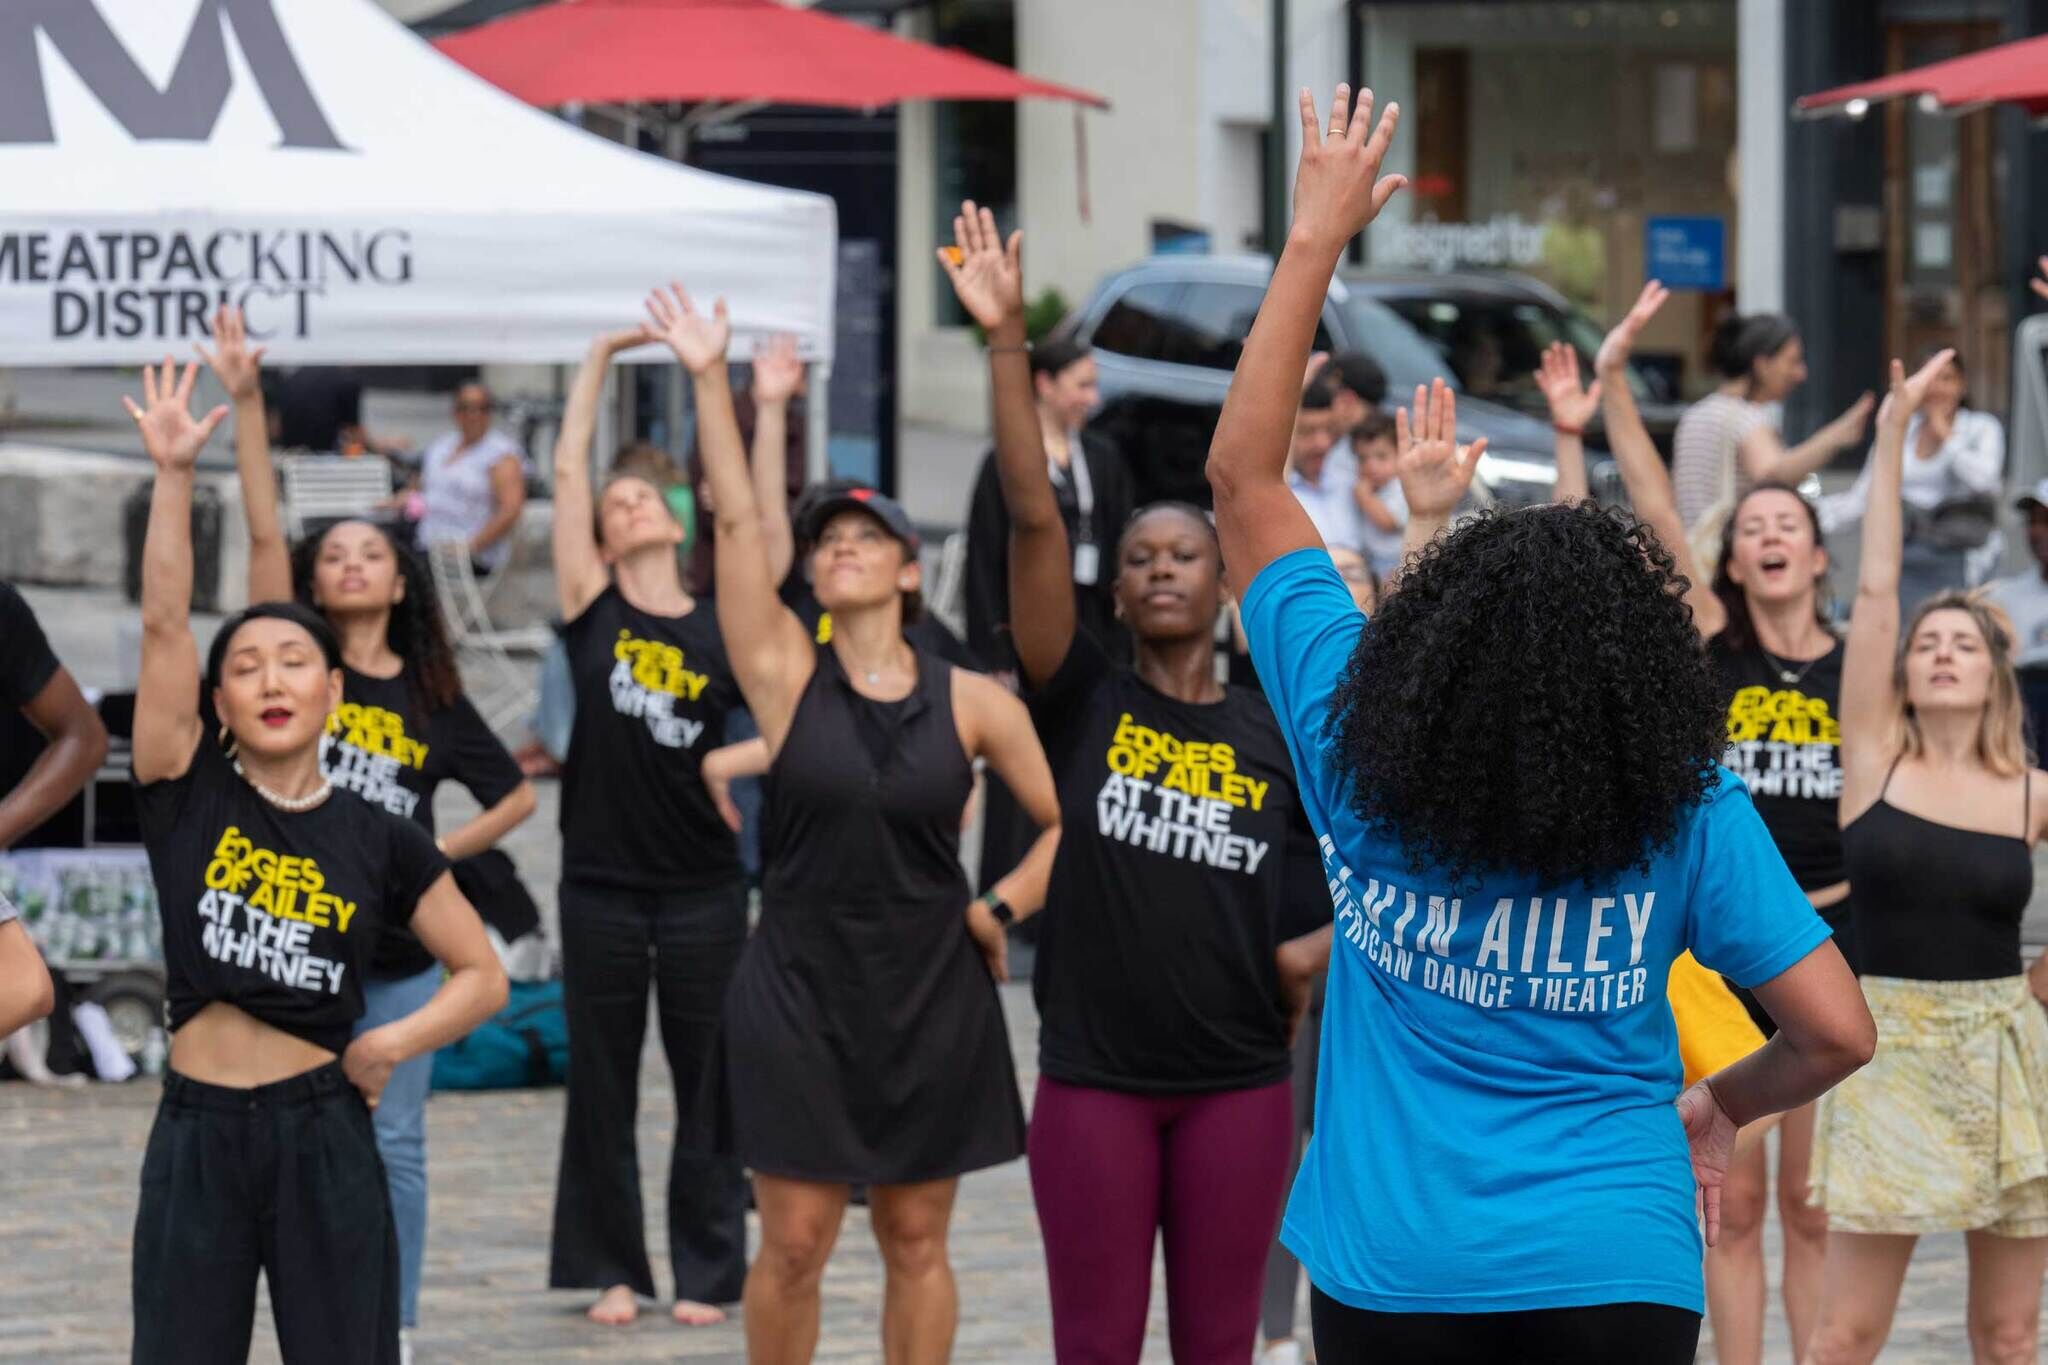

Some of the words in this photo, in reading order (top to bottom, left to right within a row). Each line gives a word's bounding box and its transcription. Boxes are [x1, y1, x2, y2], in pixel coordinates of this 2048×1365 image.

[1113, 712, 1236, 774] EDGES
[1765, 741, 1833, 770] THE
[1769, 717, 1841, 745] AILE
[1097, 772, 1152, 811] AT
[1154, 786, 1234, 834] THE
[1107, 744, 1161, 780] OF
[1162, 762, 1269, 812] AILEY
[1740, 767, 1844, 799] HITNE
[214, 826, 326, 894] EDGES
[1097, 798, 1269, 874] WHITNEY
[197, 888, 245, 928] AT
[243, 901, 315, 955] THE
[248, 880, 357, 934] AILEY
[1475, 892, 1656, 974] AILEY
[1423, 957, 1514, 1009] DANCE
[1528, 967, 1648, 1013] THEATER
